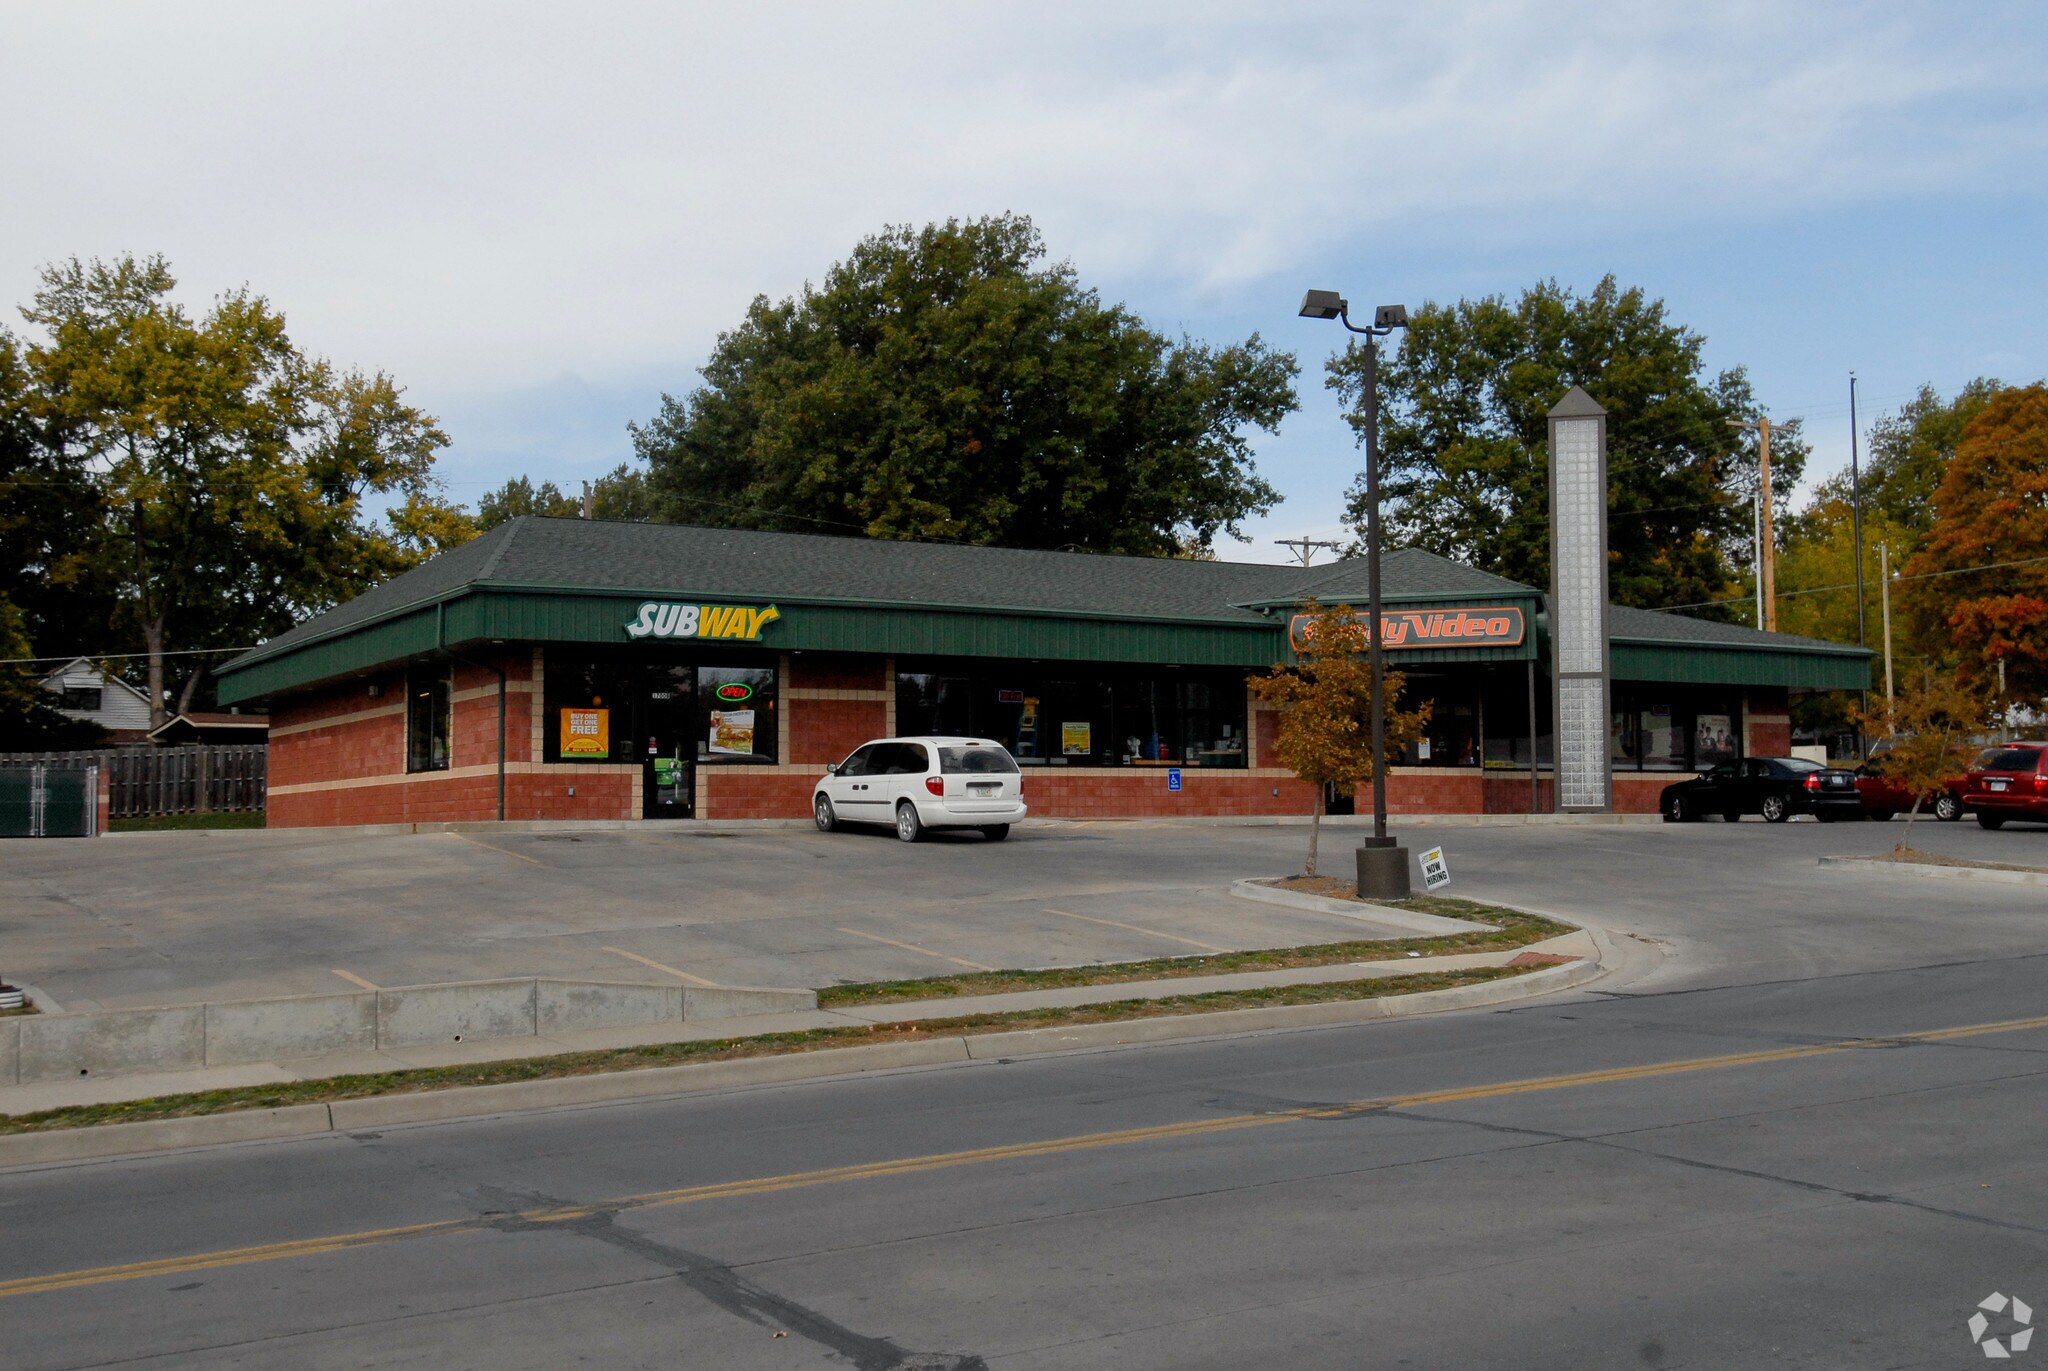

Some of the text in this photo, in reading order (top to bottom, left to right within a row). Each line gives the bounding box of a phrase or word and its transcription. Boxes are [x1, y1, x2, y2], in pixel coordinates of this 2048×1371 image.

[627, 603, 779, 639] SUBWAY
[1402, 613, 1511, 638] Video
[721, 686, 747, 698] OPEN
[570, 726, 598, 734] FREE
[1426, 861, 1441, 875] NOW
[1426, 870, 1448, 886] HIRING
